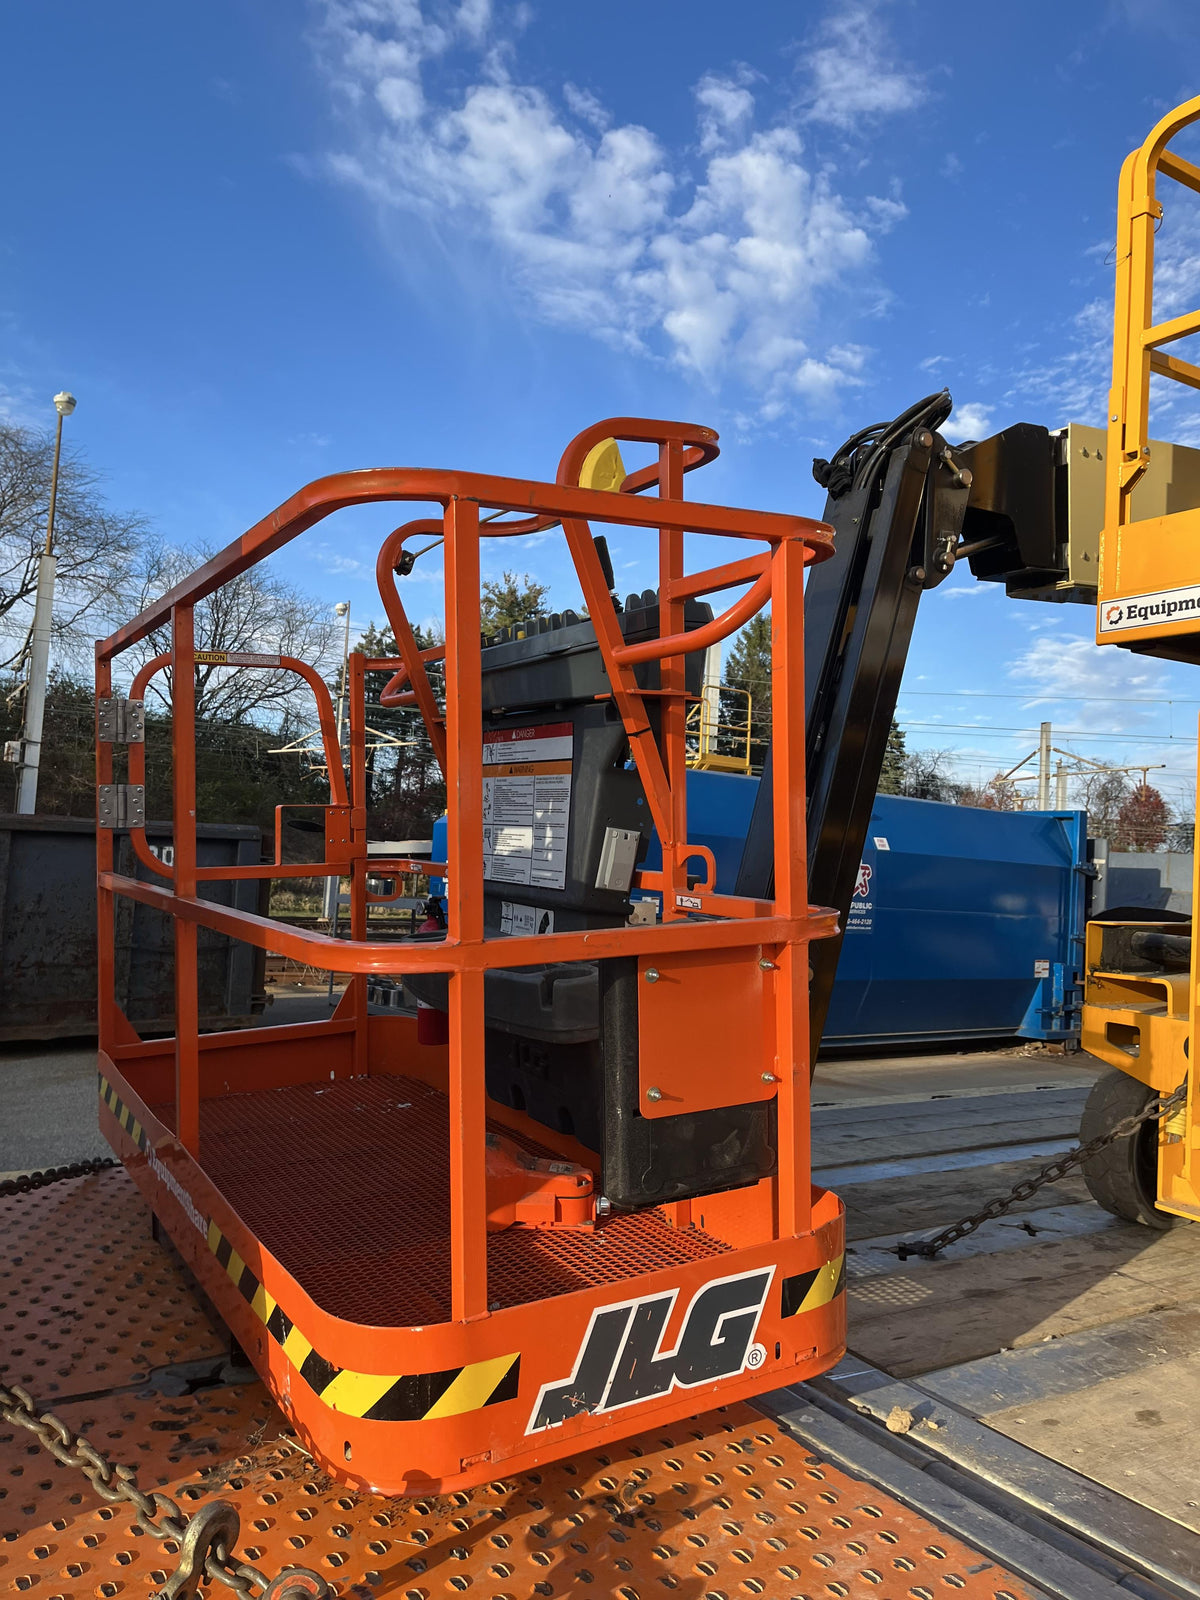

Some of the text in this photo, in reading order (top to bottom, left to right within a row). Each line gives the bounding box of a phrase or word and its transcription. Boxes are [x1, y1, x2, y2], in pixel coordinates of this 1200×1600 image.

[194, 653, 225, 662] CAUTION
[516, 728, 535, 739] DANGER
[524, 1264, 777, 1436] JLG
